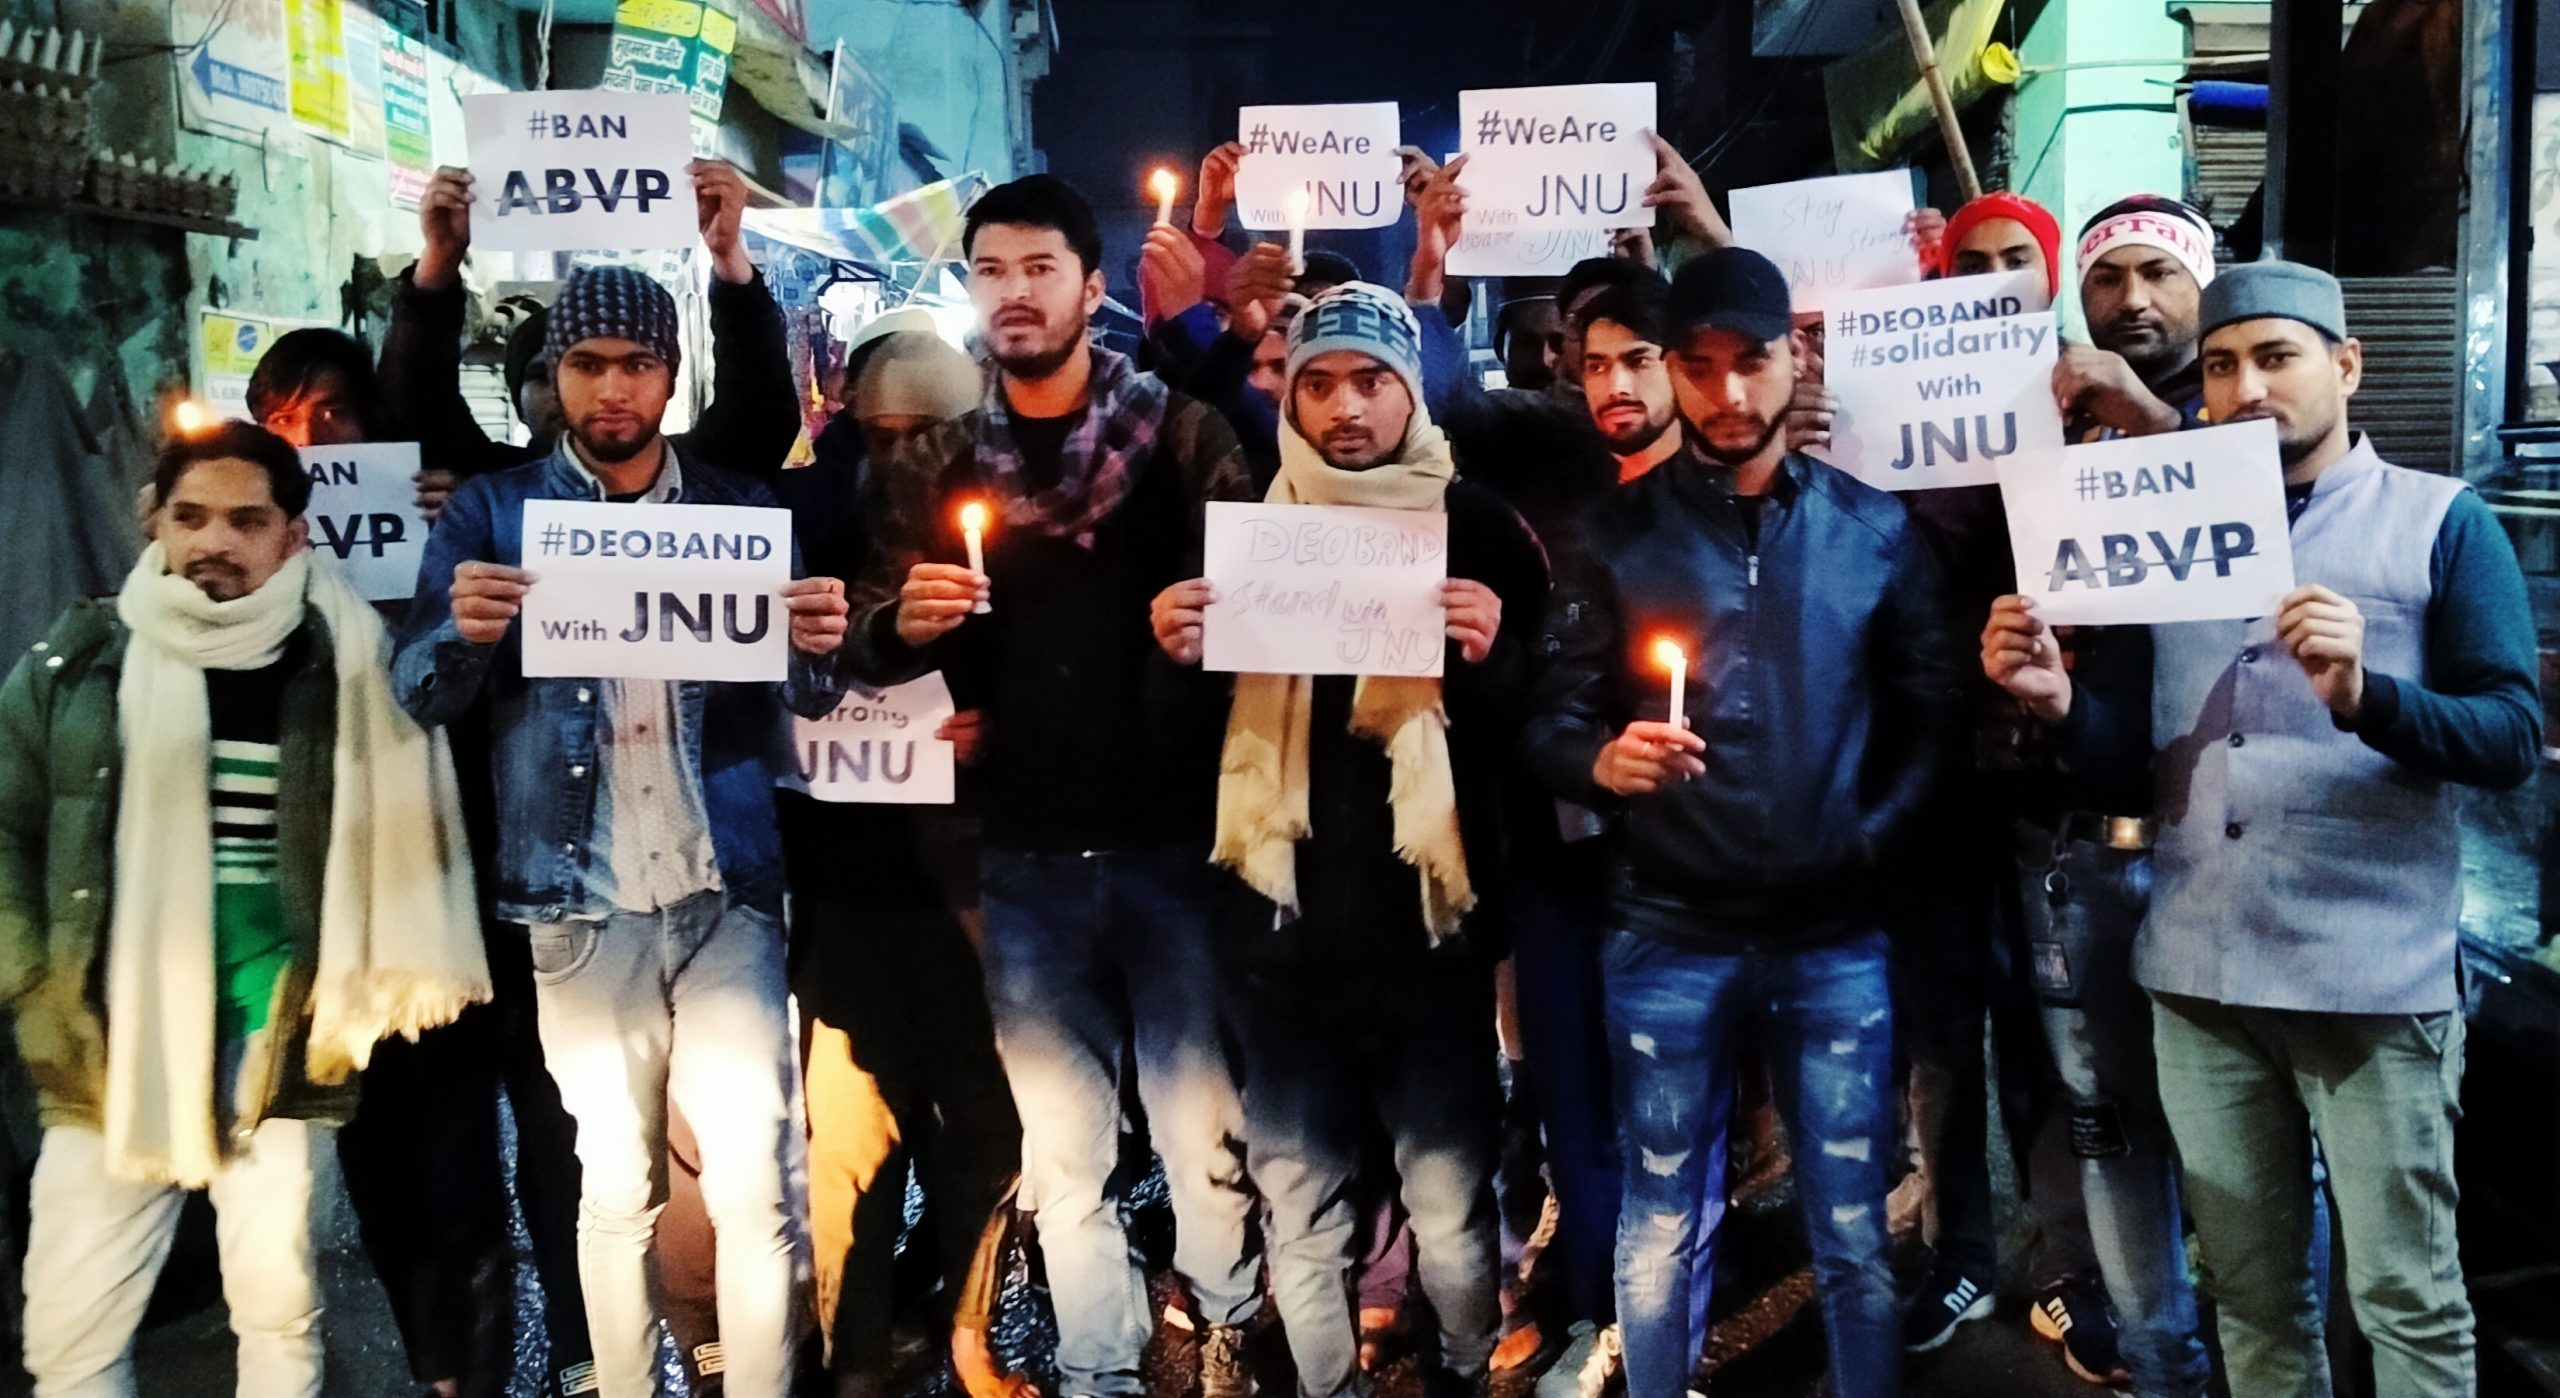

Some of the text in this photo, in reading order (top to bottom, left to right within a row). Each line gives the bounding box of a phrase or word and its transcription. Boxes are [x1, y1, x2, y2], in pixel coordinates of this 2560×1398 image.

[528, 110, 627, 139] #BAN
[1249, 124, 1371, 155] #WeAre
[1477, 110, 1617, 145] #WeAre
[496, 168, 671, 216] ABVP
[1478, 173, 1628, 225] With JNU
[1252, 208, 1286, 223] With
[1779, 256, 1846, 291] NU
[1837, 296, 2022, 337] #DEOBAND
[1851, 321, 2048, 368] #solidarity
[1917, 373, 1981, 401] With
[1890, 411, 2018, 470] JNU
[309, 461, 358, 486] AN
[2075, 461, 2196, 501] #BAN
[315, 512, 406, 560] VP
[540, 522, 772, 561] #DEOBAND
[2045, 521, 2259, 592] ABVP
[541, 591, 769, 645] With JNU
